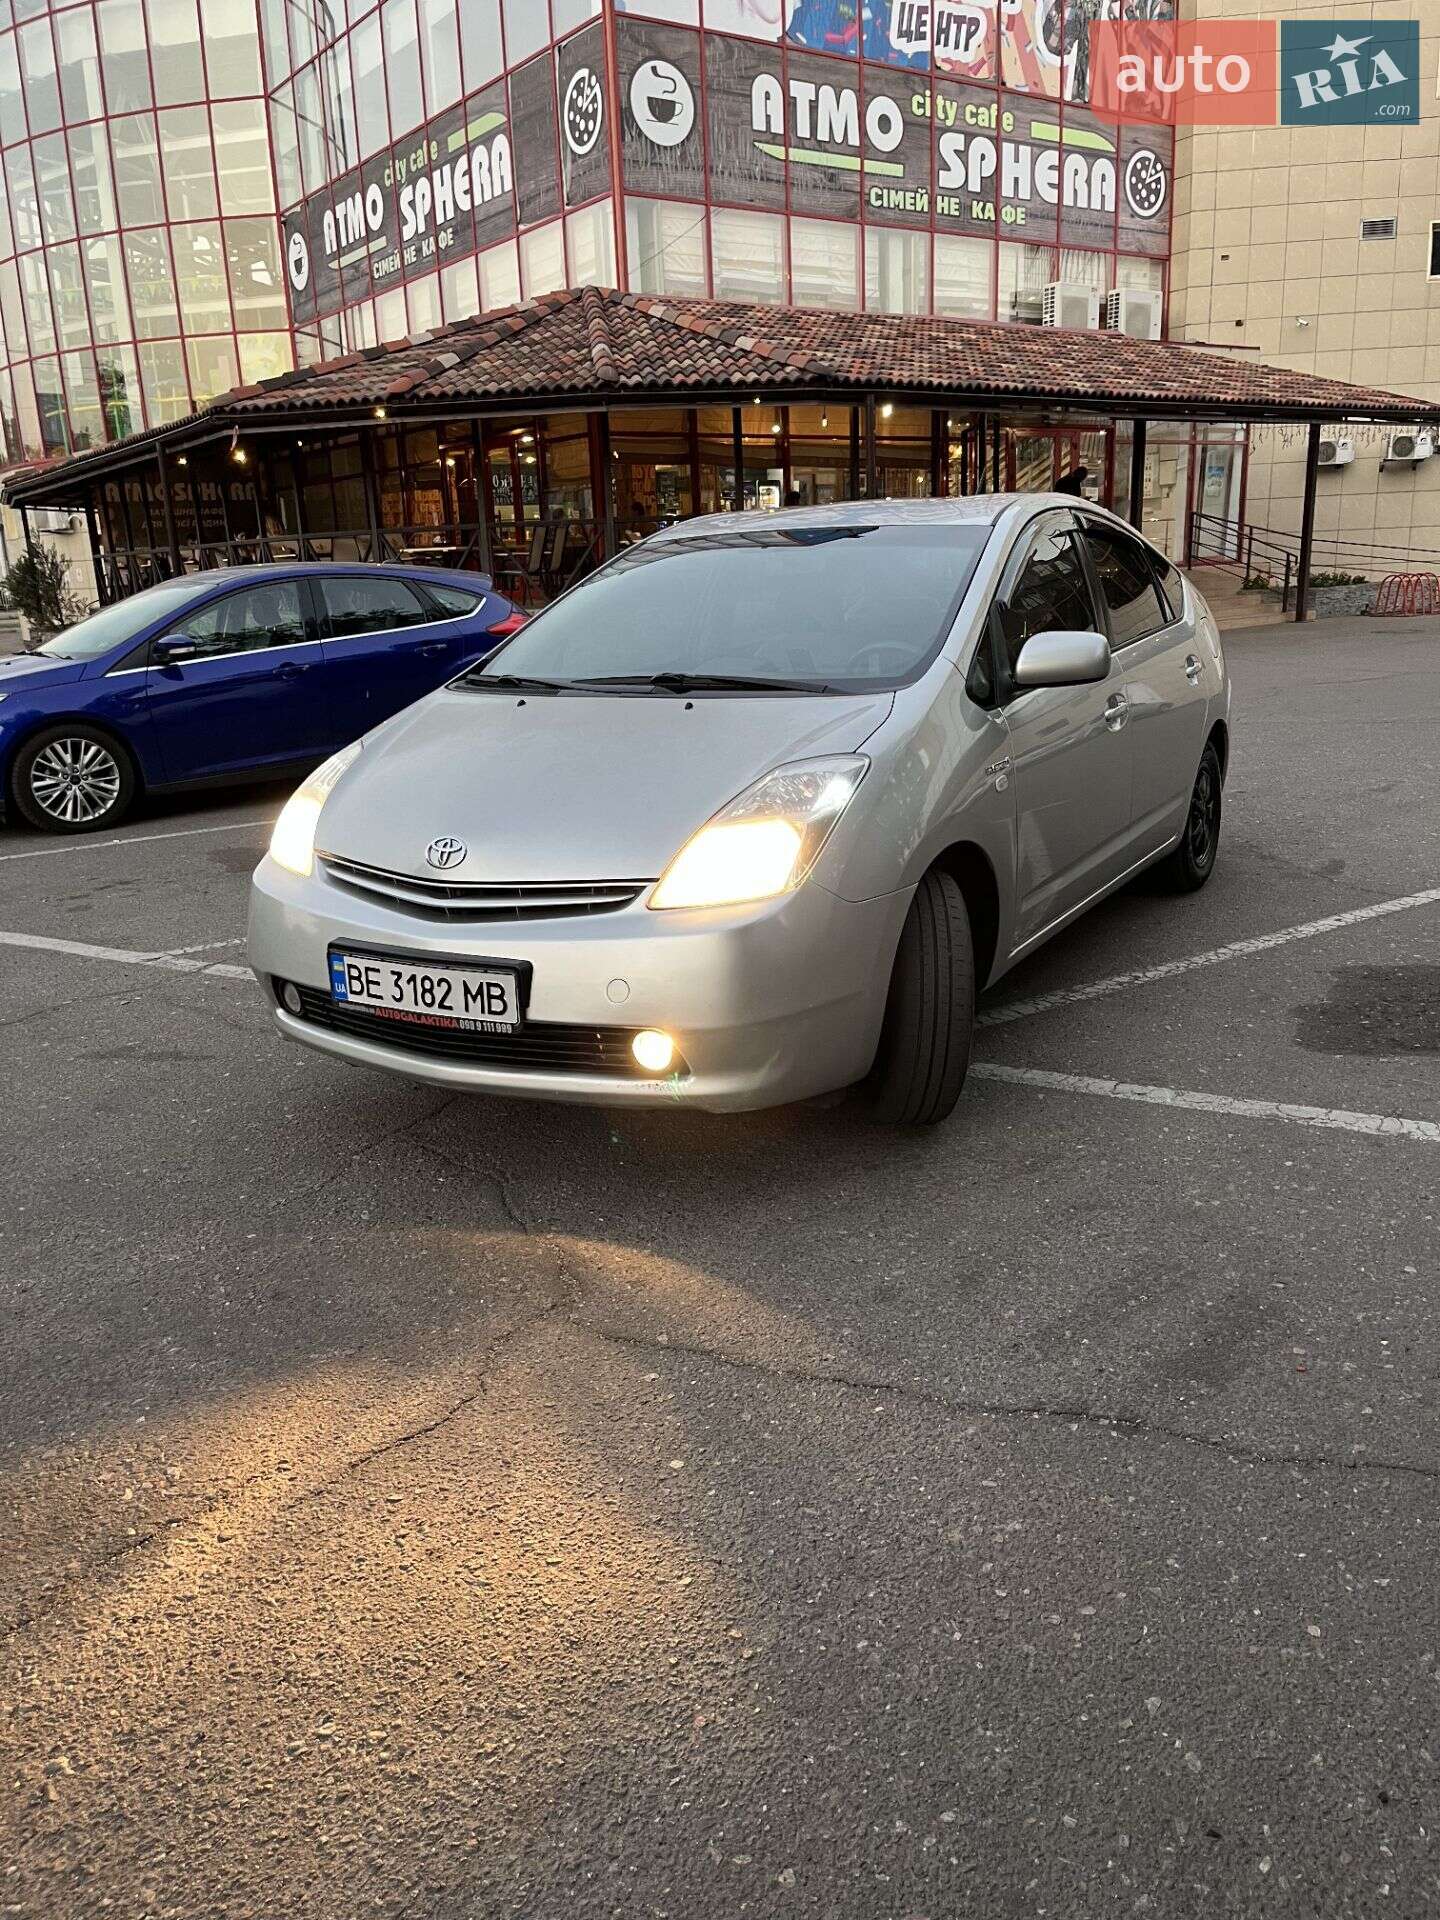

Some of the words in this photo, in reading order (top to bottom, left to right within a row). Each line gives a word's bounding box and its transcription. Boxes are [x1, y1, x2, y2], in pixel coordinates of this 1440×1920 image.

[896, 3, 980, 54] ЦЕНТР
[751, 73, 904, 153] ATMO
[911, 90, 958, 126] city
[965, 103, 1015, 133] cafe
[399, 133, 514, 242] SPHERA
[938, 132, 1117, 212] SPHERA
[323, 183, 383, 255] ATMO
[335, 982, 347, 994] UA
[346, 963, 385, 1001] BE
[390, 969, 454, 1011] 3182
[463, 979, 509, 1016] MB
[375, 1007, 459, 1028] AUTOGALAKTIKA
